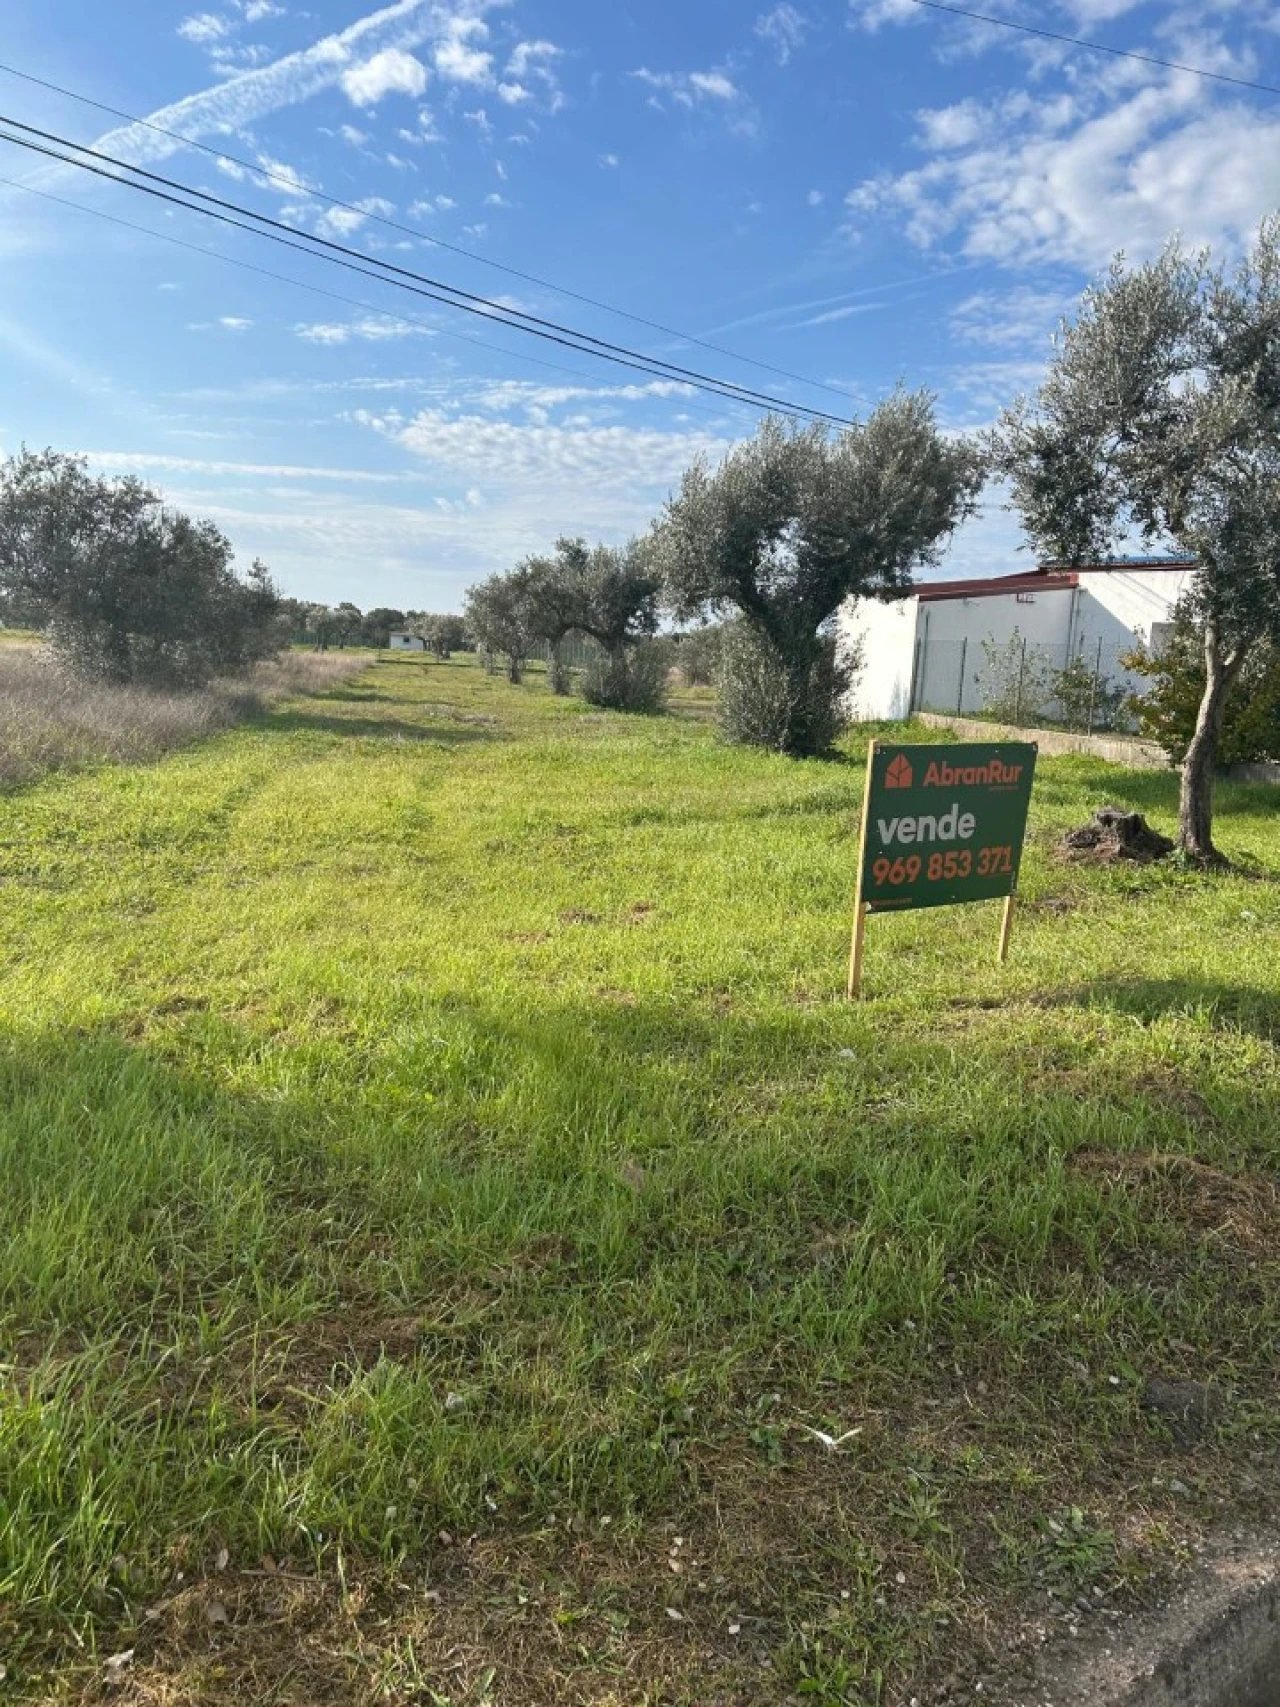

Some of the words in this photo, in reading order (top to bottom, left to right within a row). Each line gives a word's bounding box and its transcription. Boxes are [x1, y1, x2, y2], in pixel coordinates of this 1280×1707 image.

[923, 759, 1022, 786] AbranRur
[877, 803, 976, 844] vende
[872, 855, 921, 885] 969
[928, 850, 972, 880] 853
[977, 847, 1012, 875] 371
